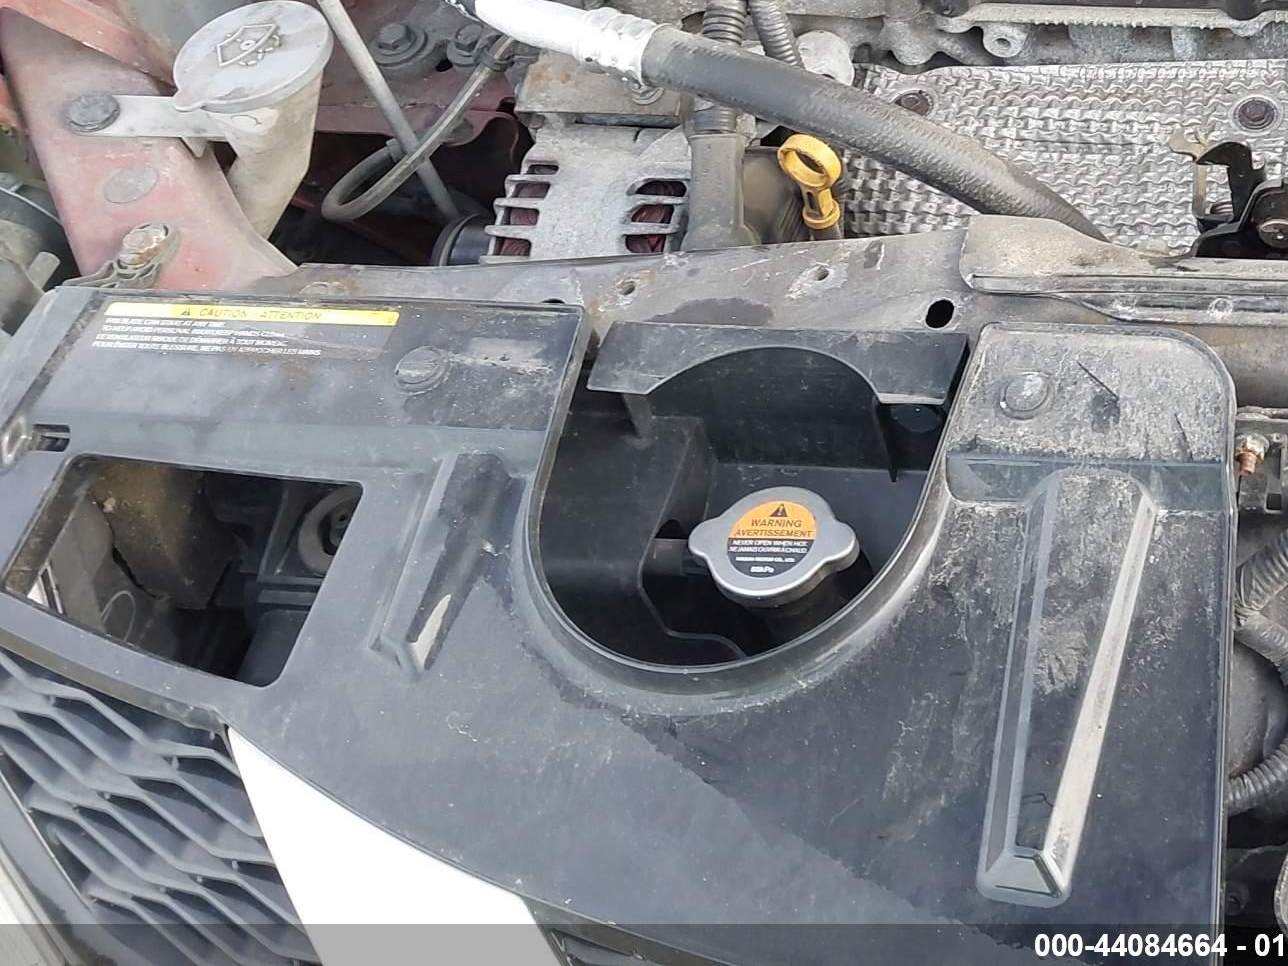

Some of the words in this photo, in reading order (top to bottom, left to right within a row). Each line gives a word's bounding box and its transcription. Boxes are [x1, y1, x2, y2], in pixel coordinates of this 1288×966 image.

[199, 308, 247, 318] CAUTION
[259, 310, 321, 320] ATTENTION
[751, 518, 802, 528] WARNING
[734, 529, 813, 538] AVERTISSEMENT
